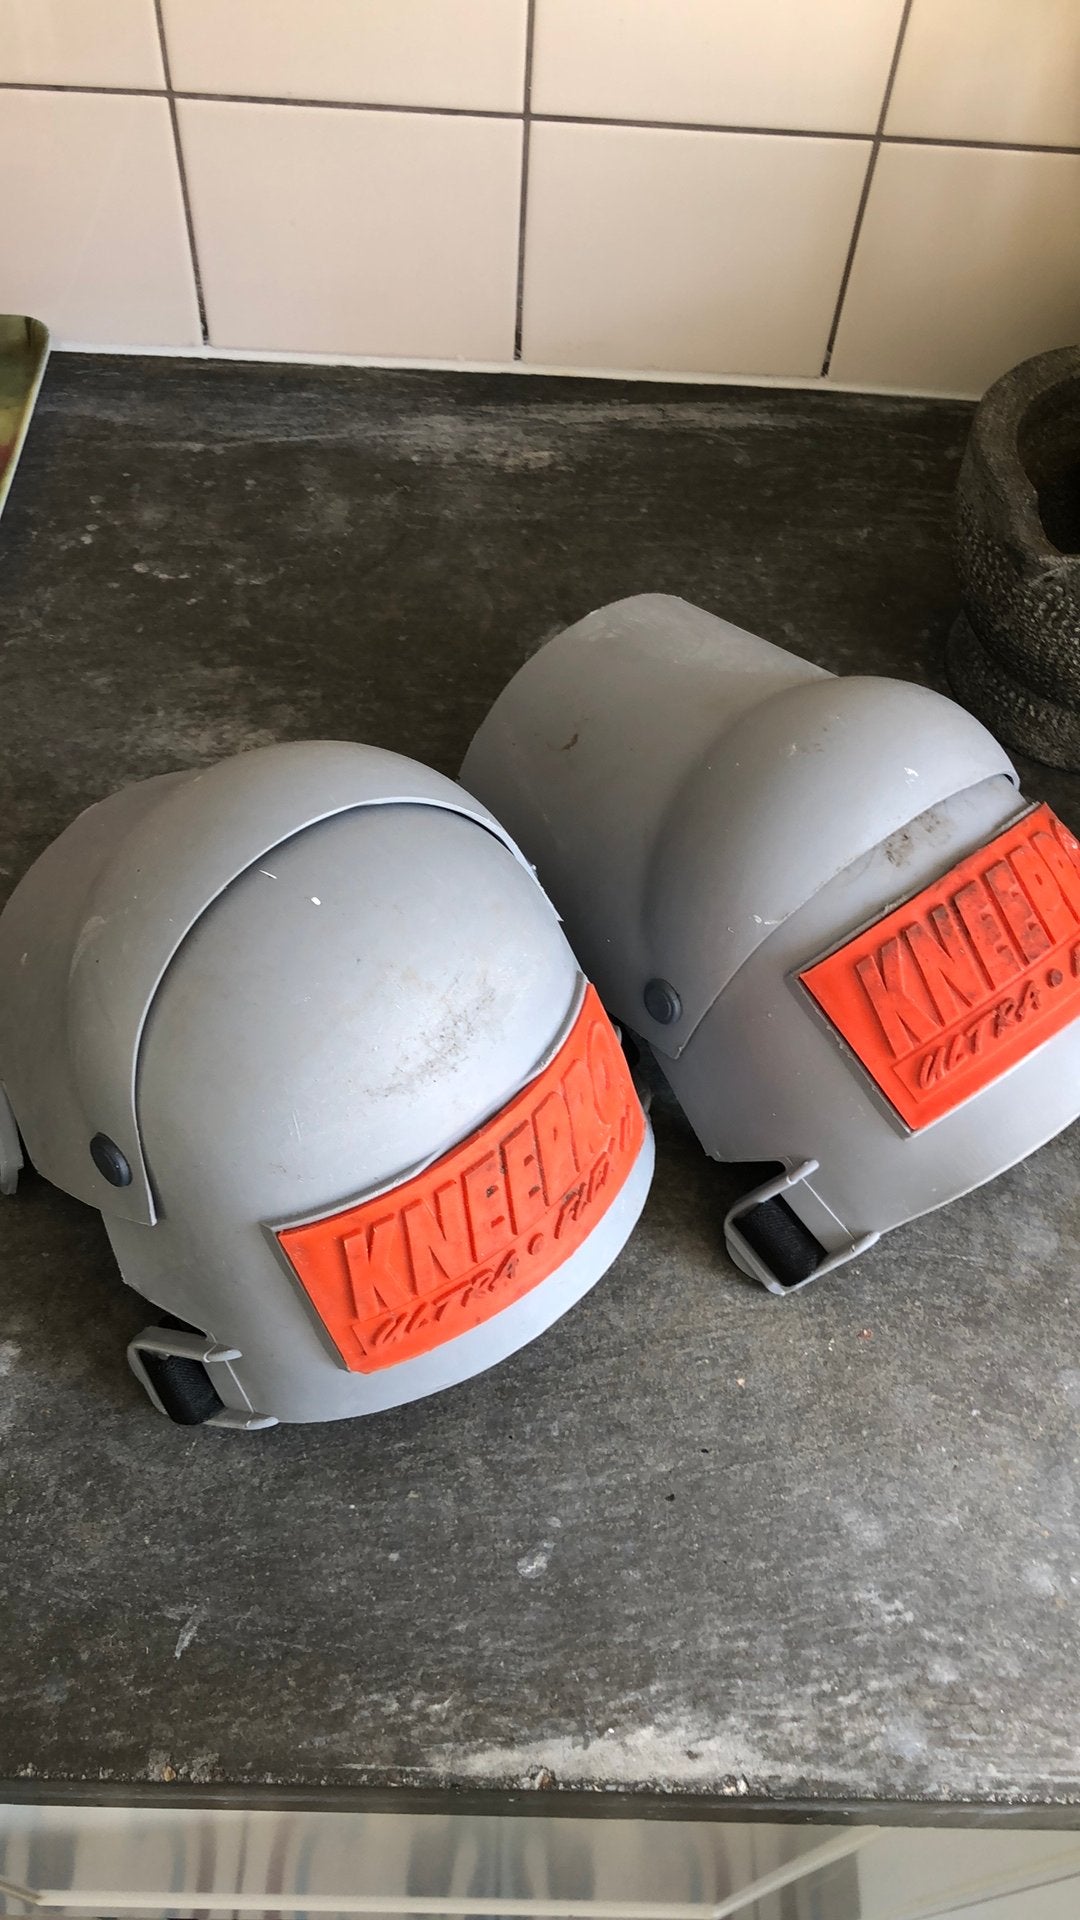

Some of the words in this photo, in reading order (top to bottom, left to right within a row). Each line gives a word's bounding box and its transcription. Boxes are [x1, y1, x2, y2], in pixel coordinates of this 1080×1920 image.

[917, 980, 1041, 1090] ULTRA
[340, 1018, 618, 1323] KNEEPRO
[371, 1246, 519, 1348] ULTRA
